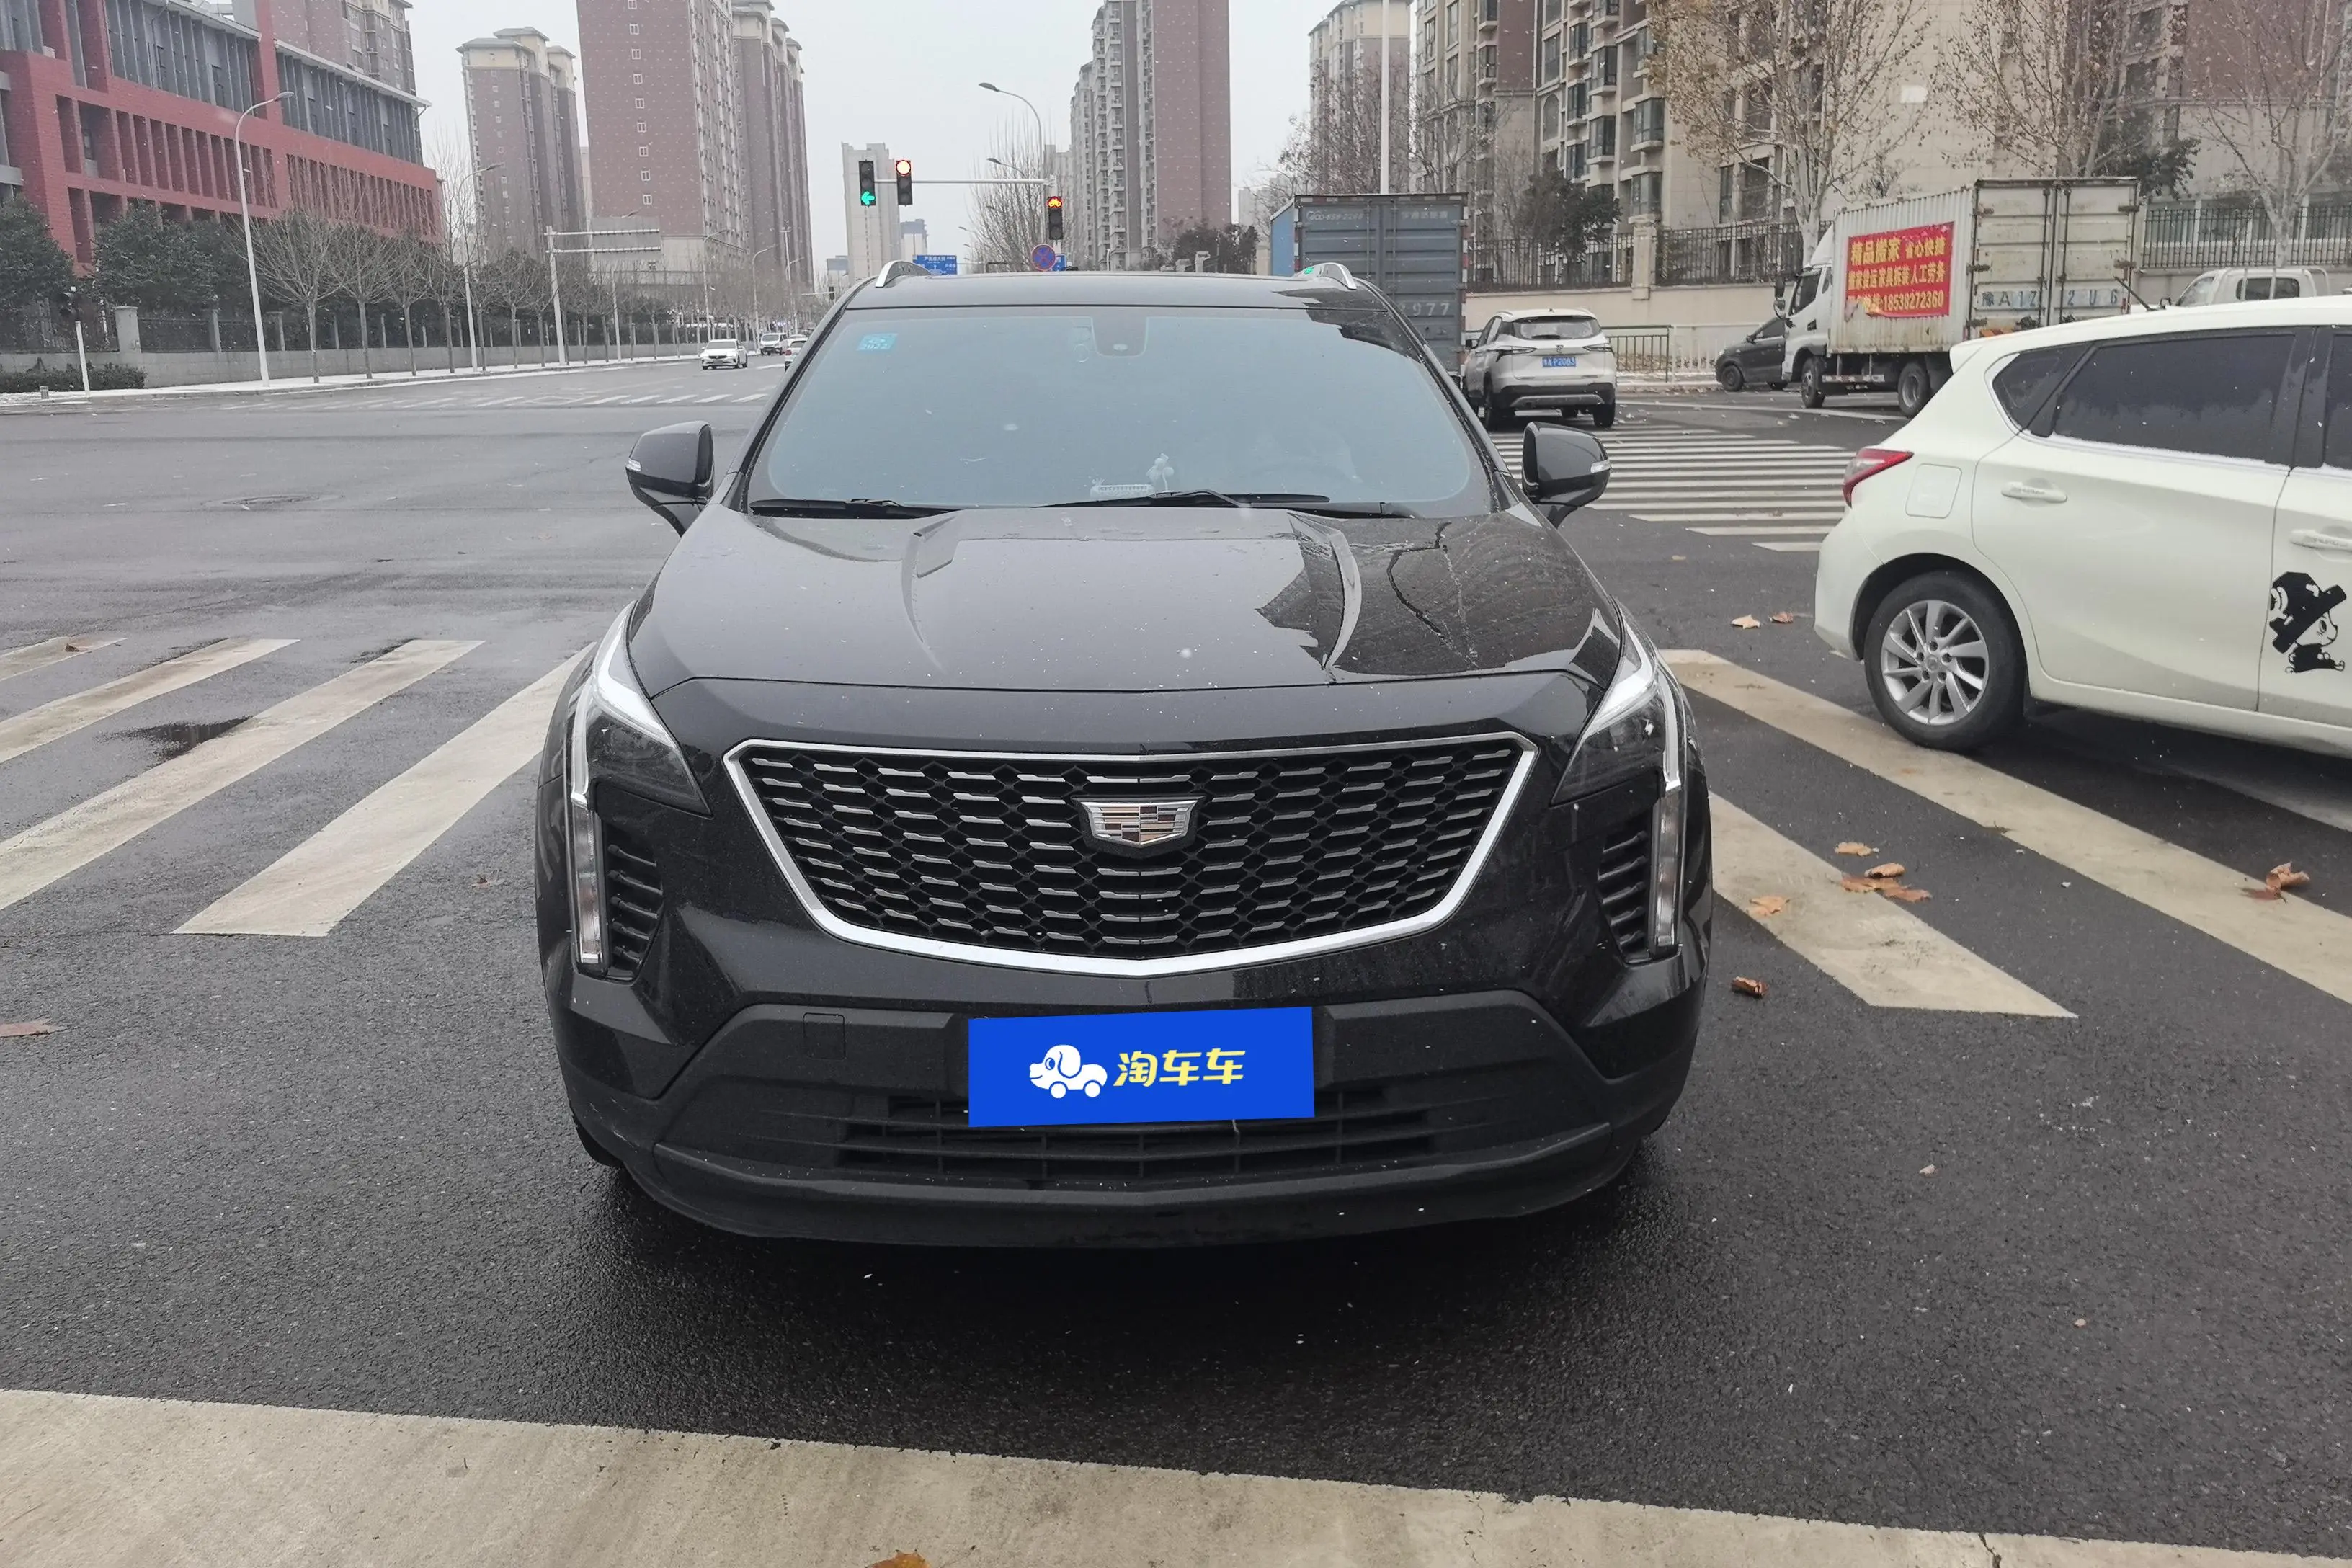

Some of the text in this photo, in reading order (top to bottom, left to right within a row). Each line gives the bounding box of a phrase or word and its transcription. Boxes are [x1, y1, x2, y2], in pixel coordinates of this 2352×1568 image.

[1850, 235, 1946, 266] 精品搬家 省心快捷
